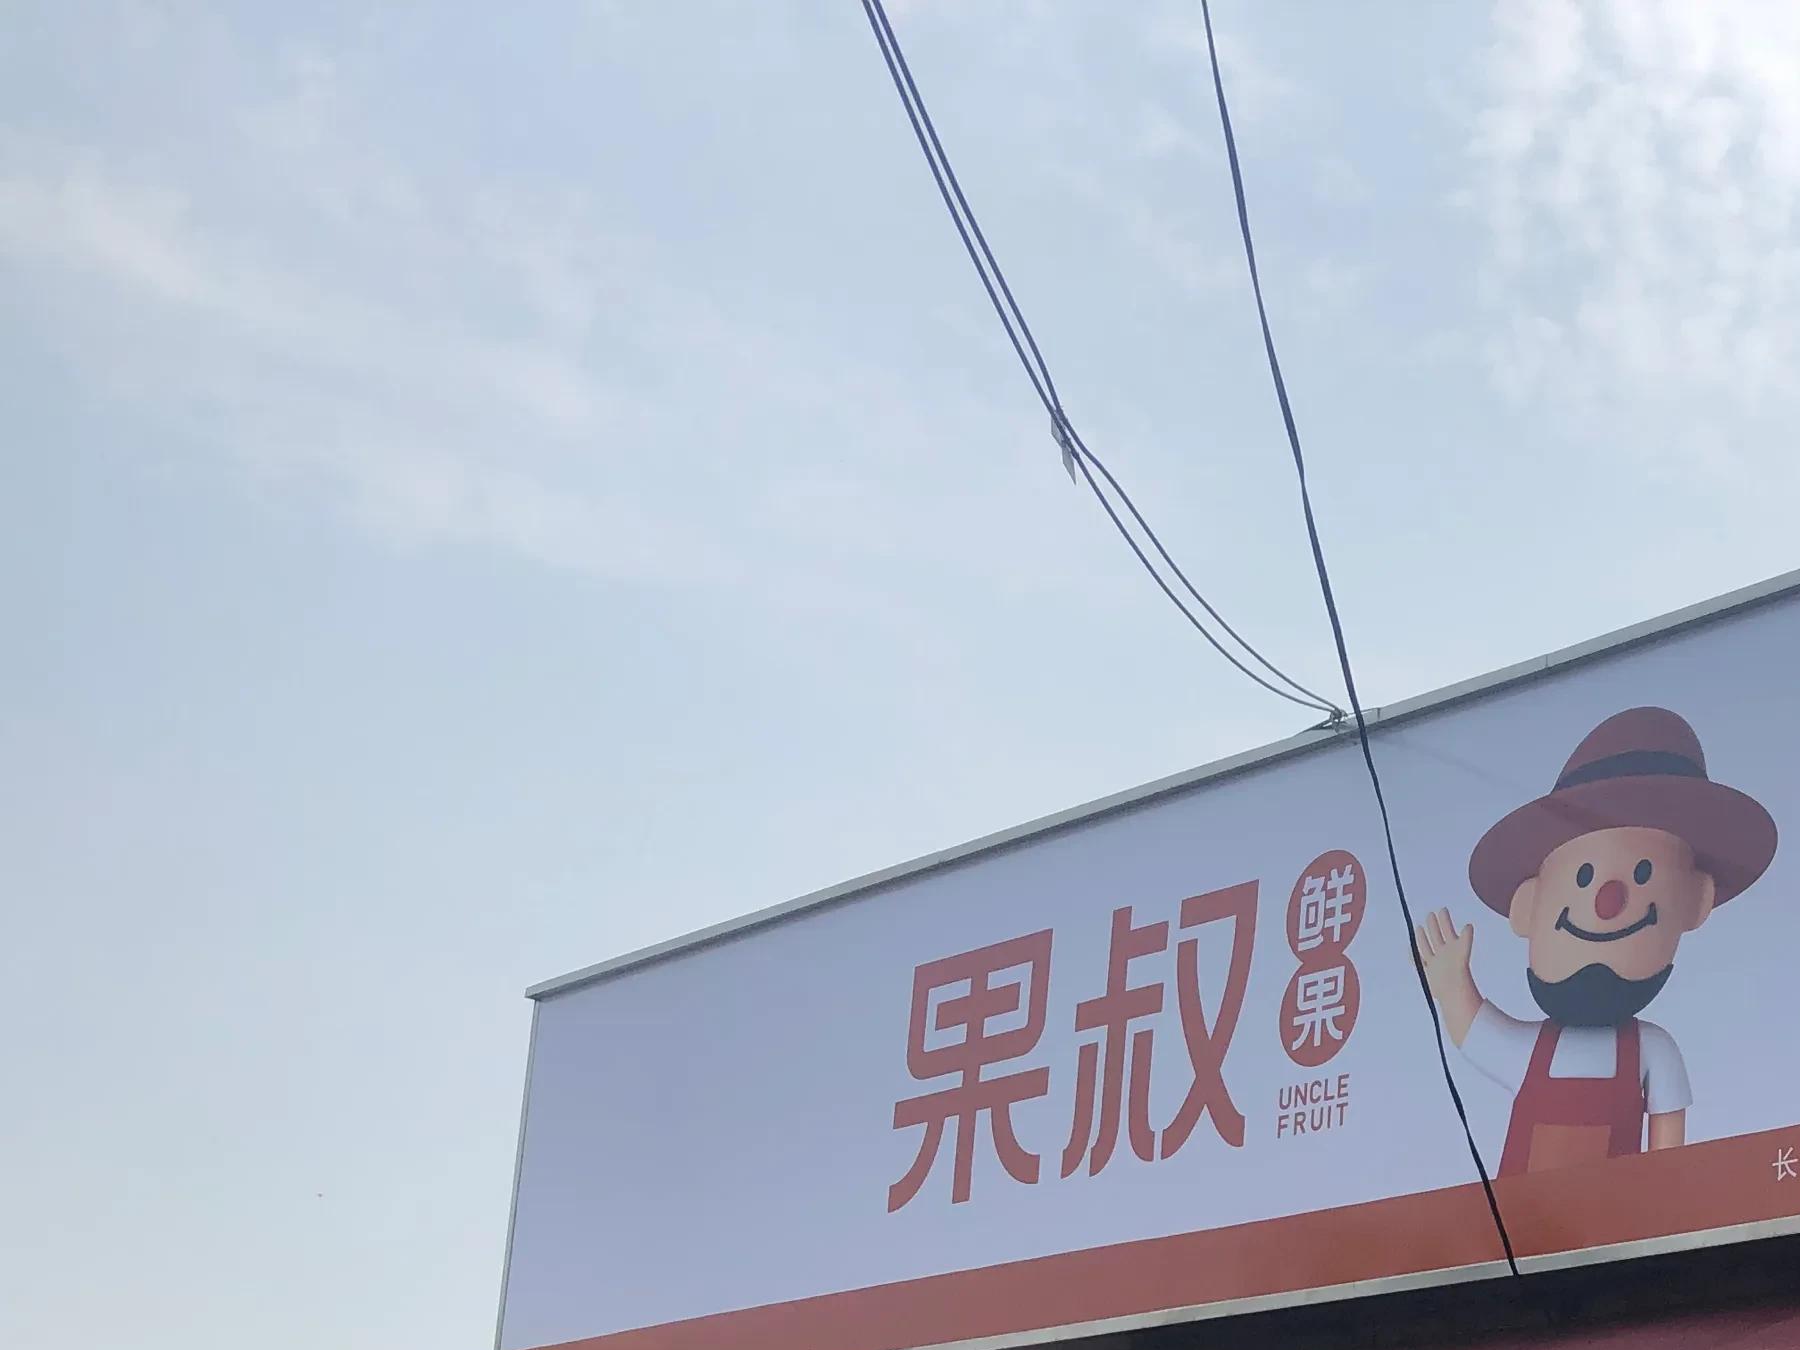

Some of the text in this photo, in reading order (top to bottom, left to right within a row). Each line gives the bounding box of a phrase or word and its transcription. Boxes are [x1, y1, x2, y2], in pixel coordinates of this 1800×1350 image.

[1292, 864, 1354, 1052] 鲜果
[888, 878, 1260, 1214] 果叔
[1278, 1073, 1350, 1108] UNCLE
[1276, 1101, 1349, 1139] FRUIT
